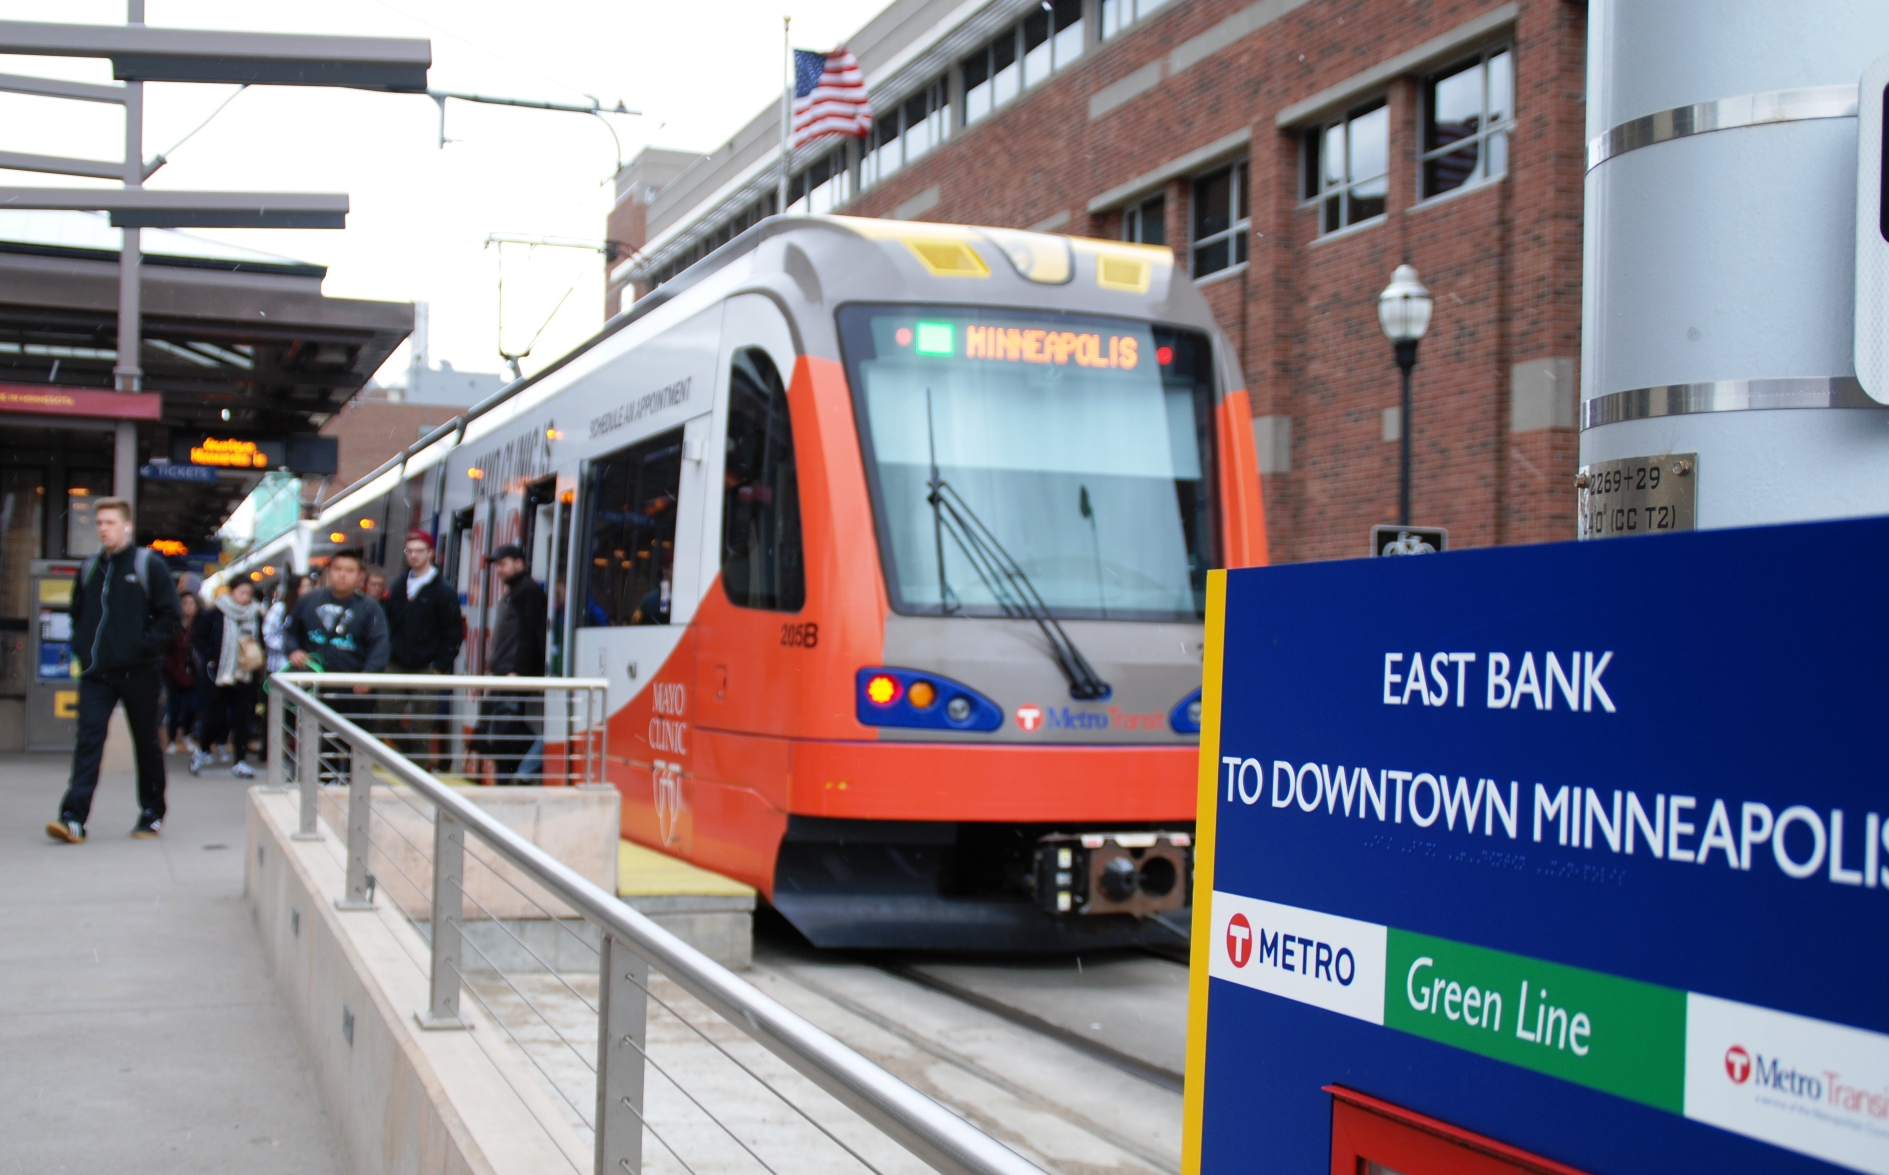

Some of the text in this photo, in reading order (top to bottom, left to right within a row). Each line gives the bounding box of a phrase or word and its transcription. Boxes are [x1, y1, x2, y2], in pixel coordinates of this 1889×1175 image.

[966, 325, 1139, 370] MINNEAPOLIS
[18, 393, 74, 406] MINNESOTA
[589, 406, 624, 440] SCHEDULE
[635, 376, 692, 420] APPOINTMENT
[158, 465, 206, 477] TICKETS
[1590, 466, 1661, 495] 2269+29
[1611, 507, 1637, 532] (CC
[1645, 505, 1675, 529] T2)
[780, 623, 819, 648] 205B
[653, 682, 686, 716] MAYO
[1384, 651, 1616, 713] EAST BANK
[649, 718, 688, 755] CLINIC
[1223, 756, 1263, 805] TO
[1271, 760, 1519, 839] DOWNTOWN
[1259, 927, 1355, 987] METRO
[1406, 956, 1591, 1056] Green Line
